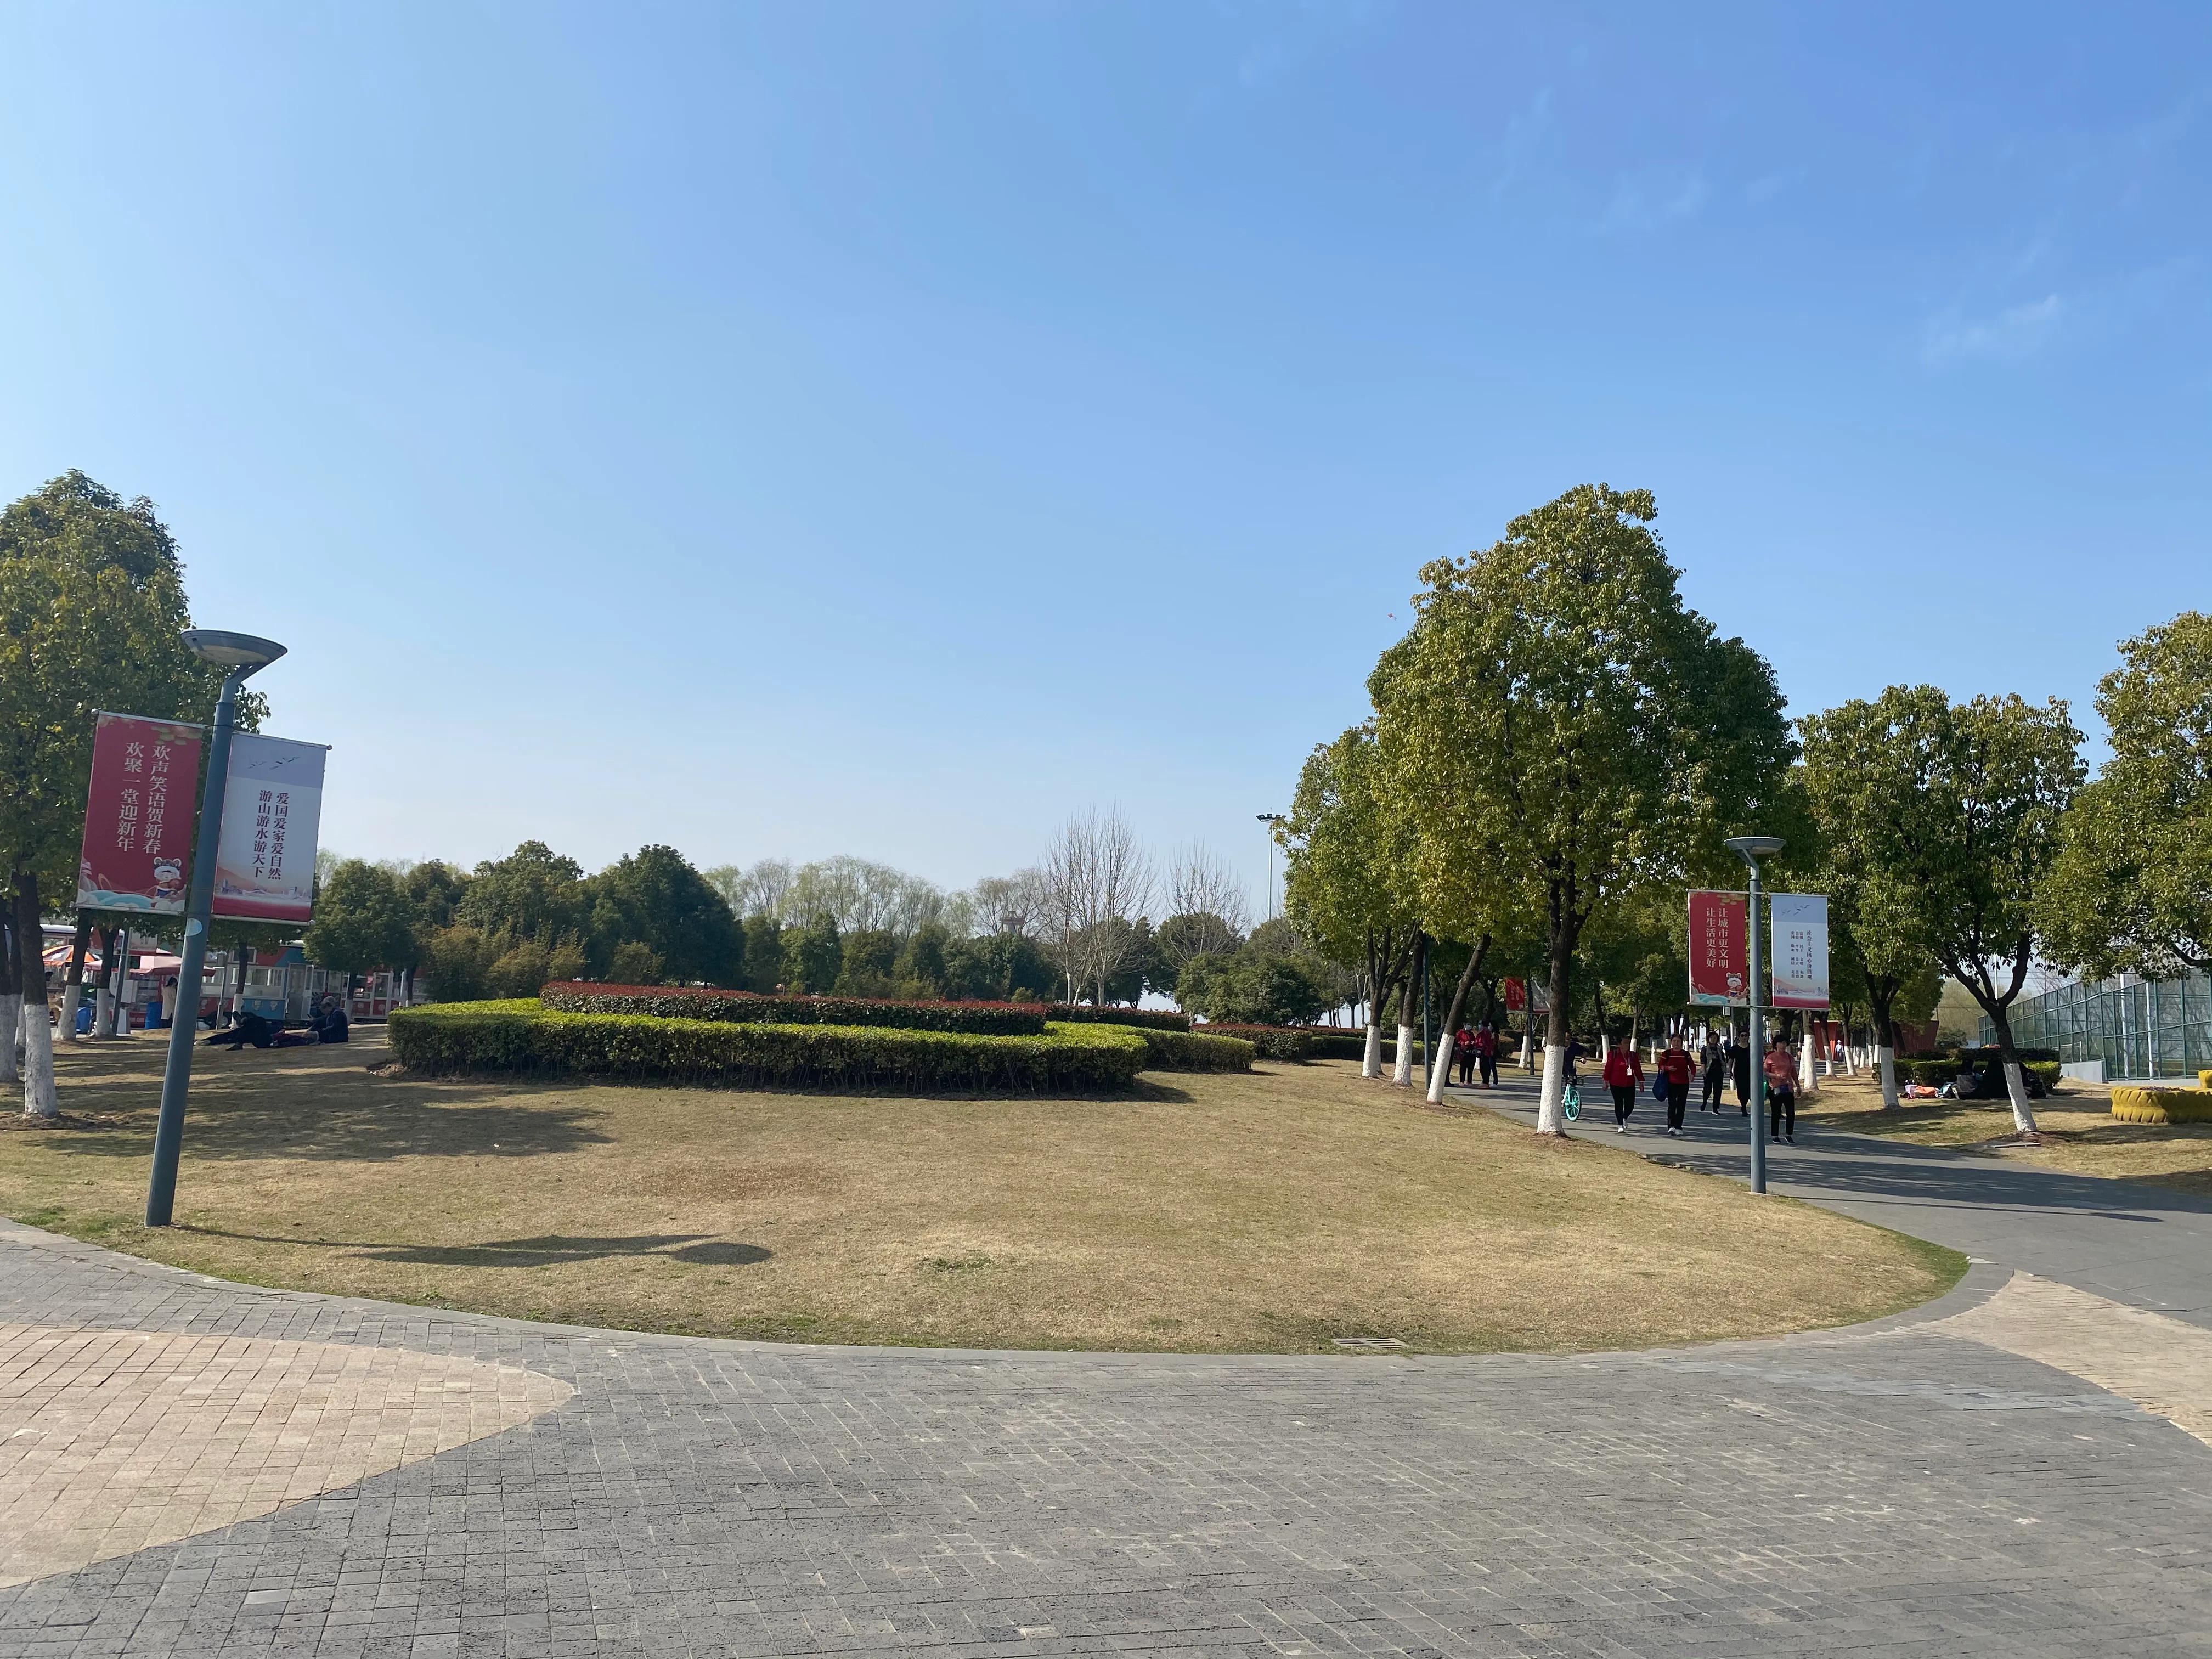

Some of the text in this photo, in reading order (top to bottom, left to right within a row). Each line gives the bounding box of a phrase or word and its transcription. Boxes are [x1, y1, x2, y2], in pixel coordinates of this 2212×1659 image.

[115, 742, 144, 852] 欢聚一堂迎新年
[142, 745, 171, 854] 欢声笑语贺新春
[252, 790, 273, 878] 游山游水游天下
[268, 793, 290, 880] 爱国爱家爱自然
[1706, 907, 1716, 968] 让生活更美好
[1718, 908, 1729, 969] 让城市更文明
